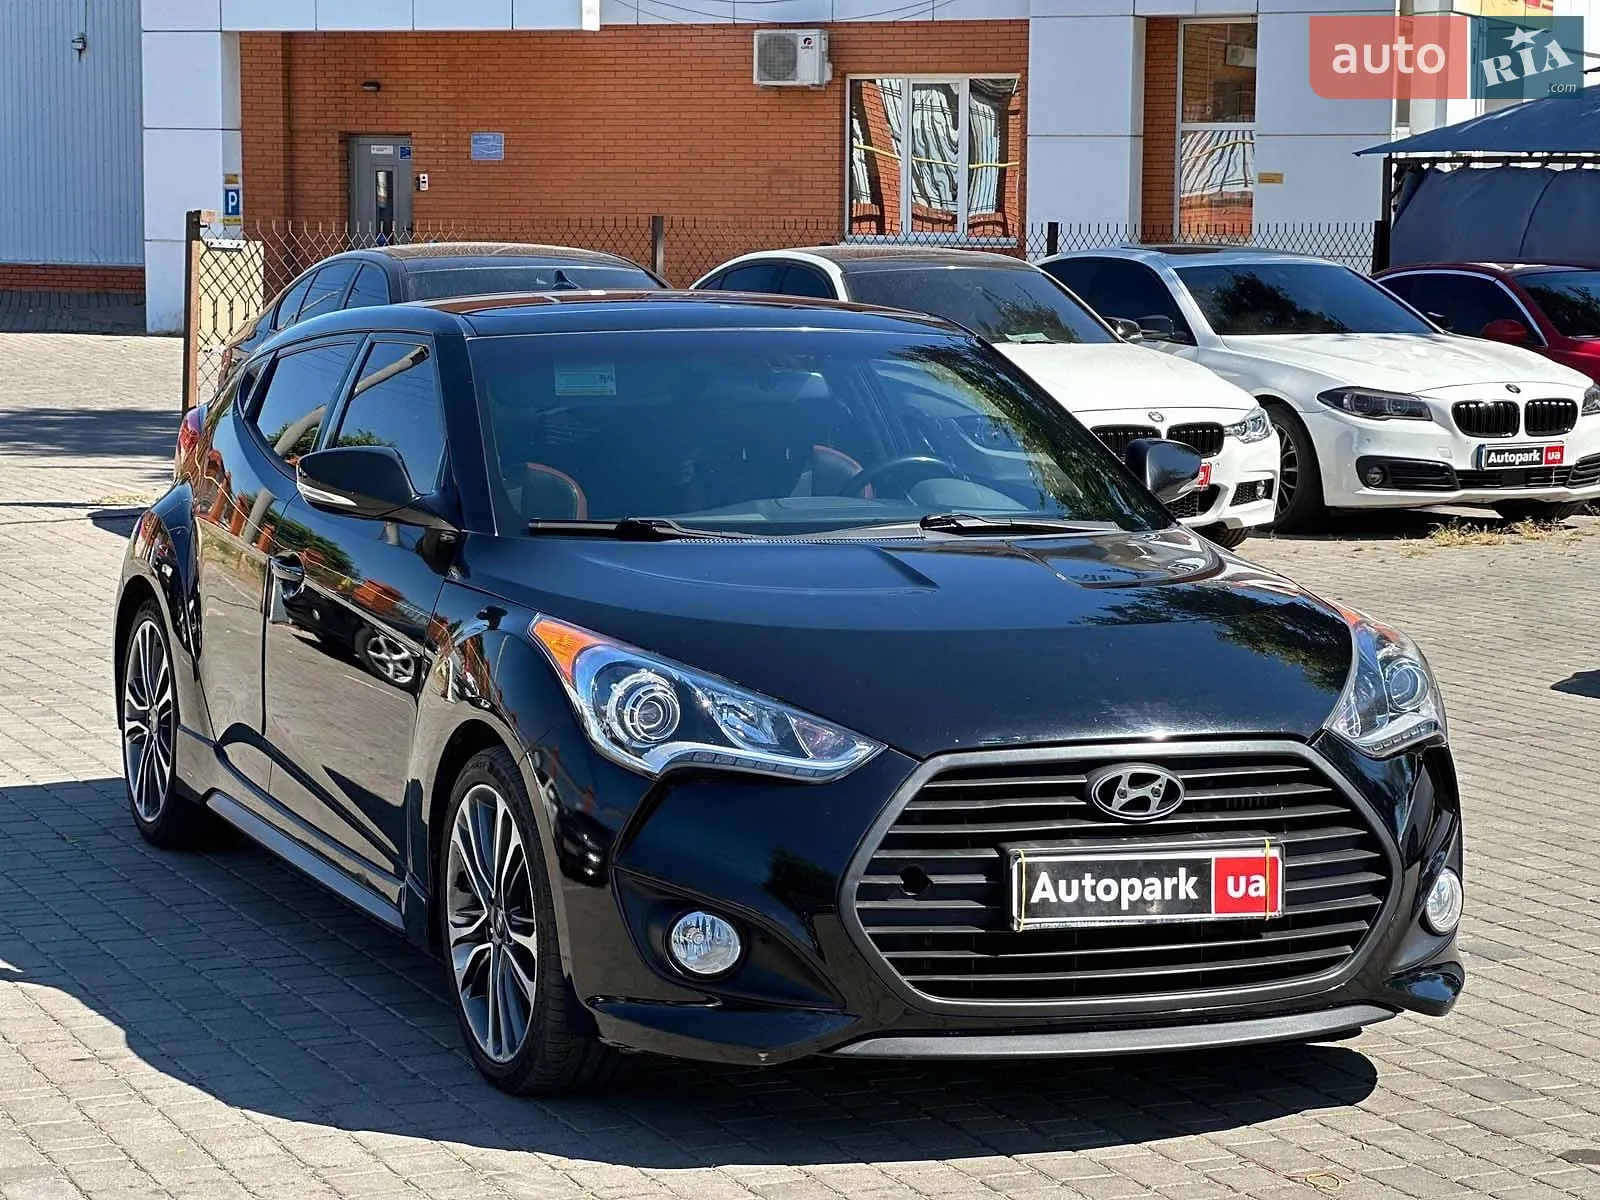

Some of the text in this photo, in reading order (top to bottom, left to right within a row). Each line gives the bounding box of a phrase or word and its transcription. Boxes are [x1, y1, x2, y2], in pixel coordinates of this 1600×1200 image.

[228, 191, 238, 213] P
[1487, 449, 1561, 466] Autopark ua
[1030, 867, 1268, 911] Autopark ua
